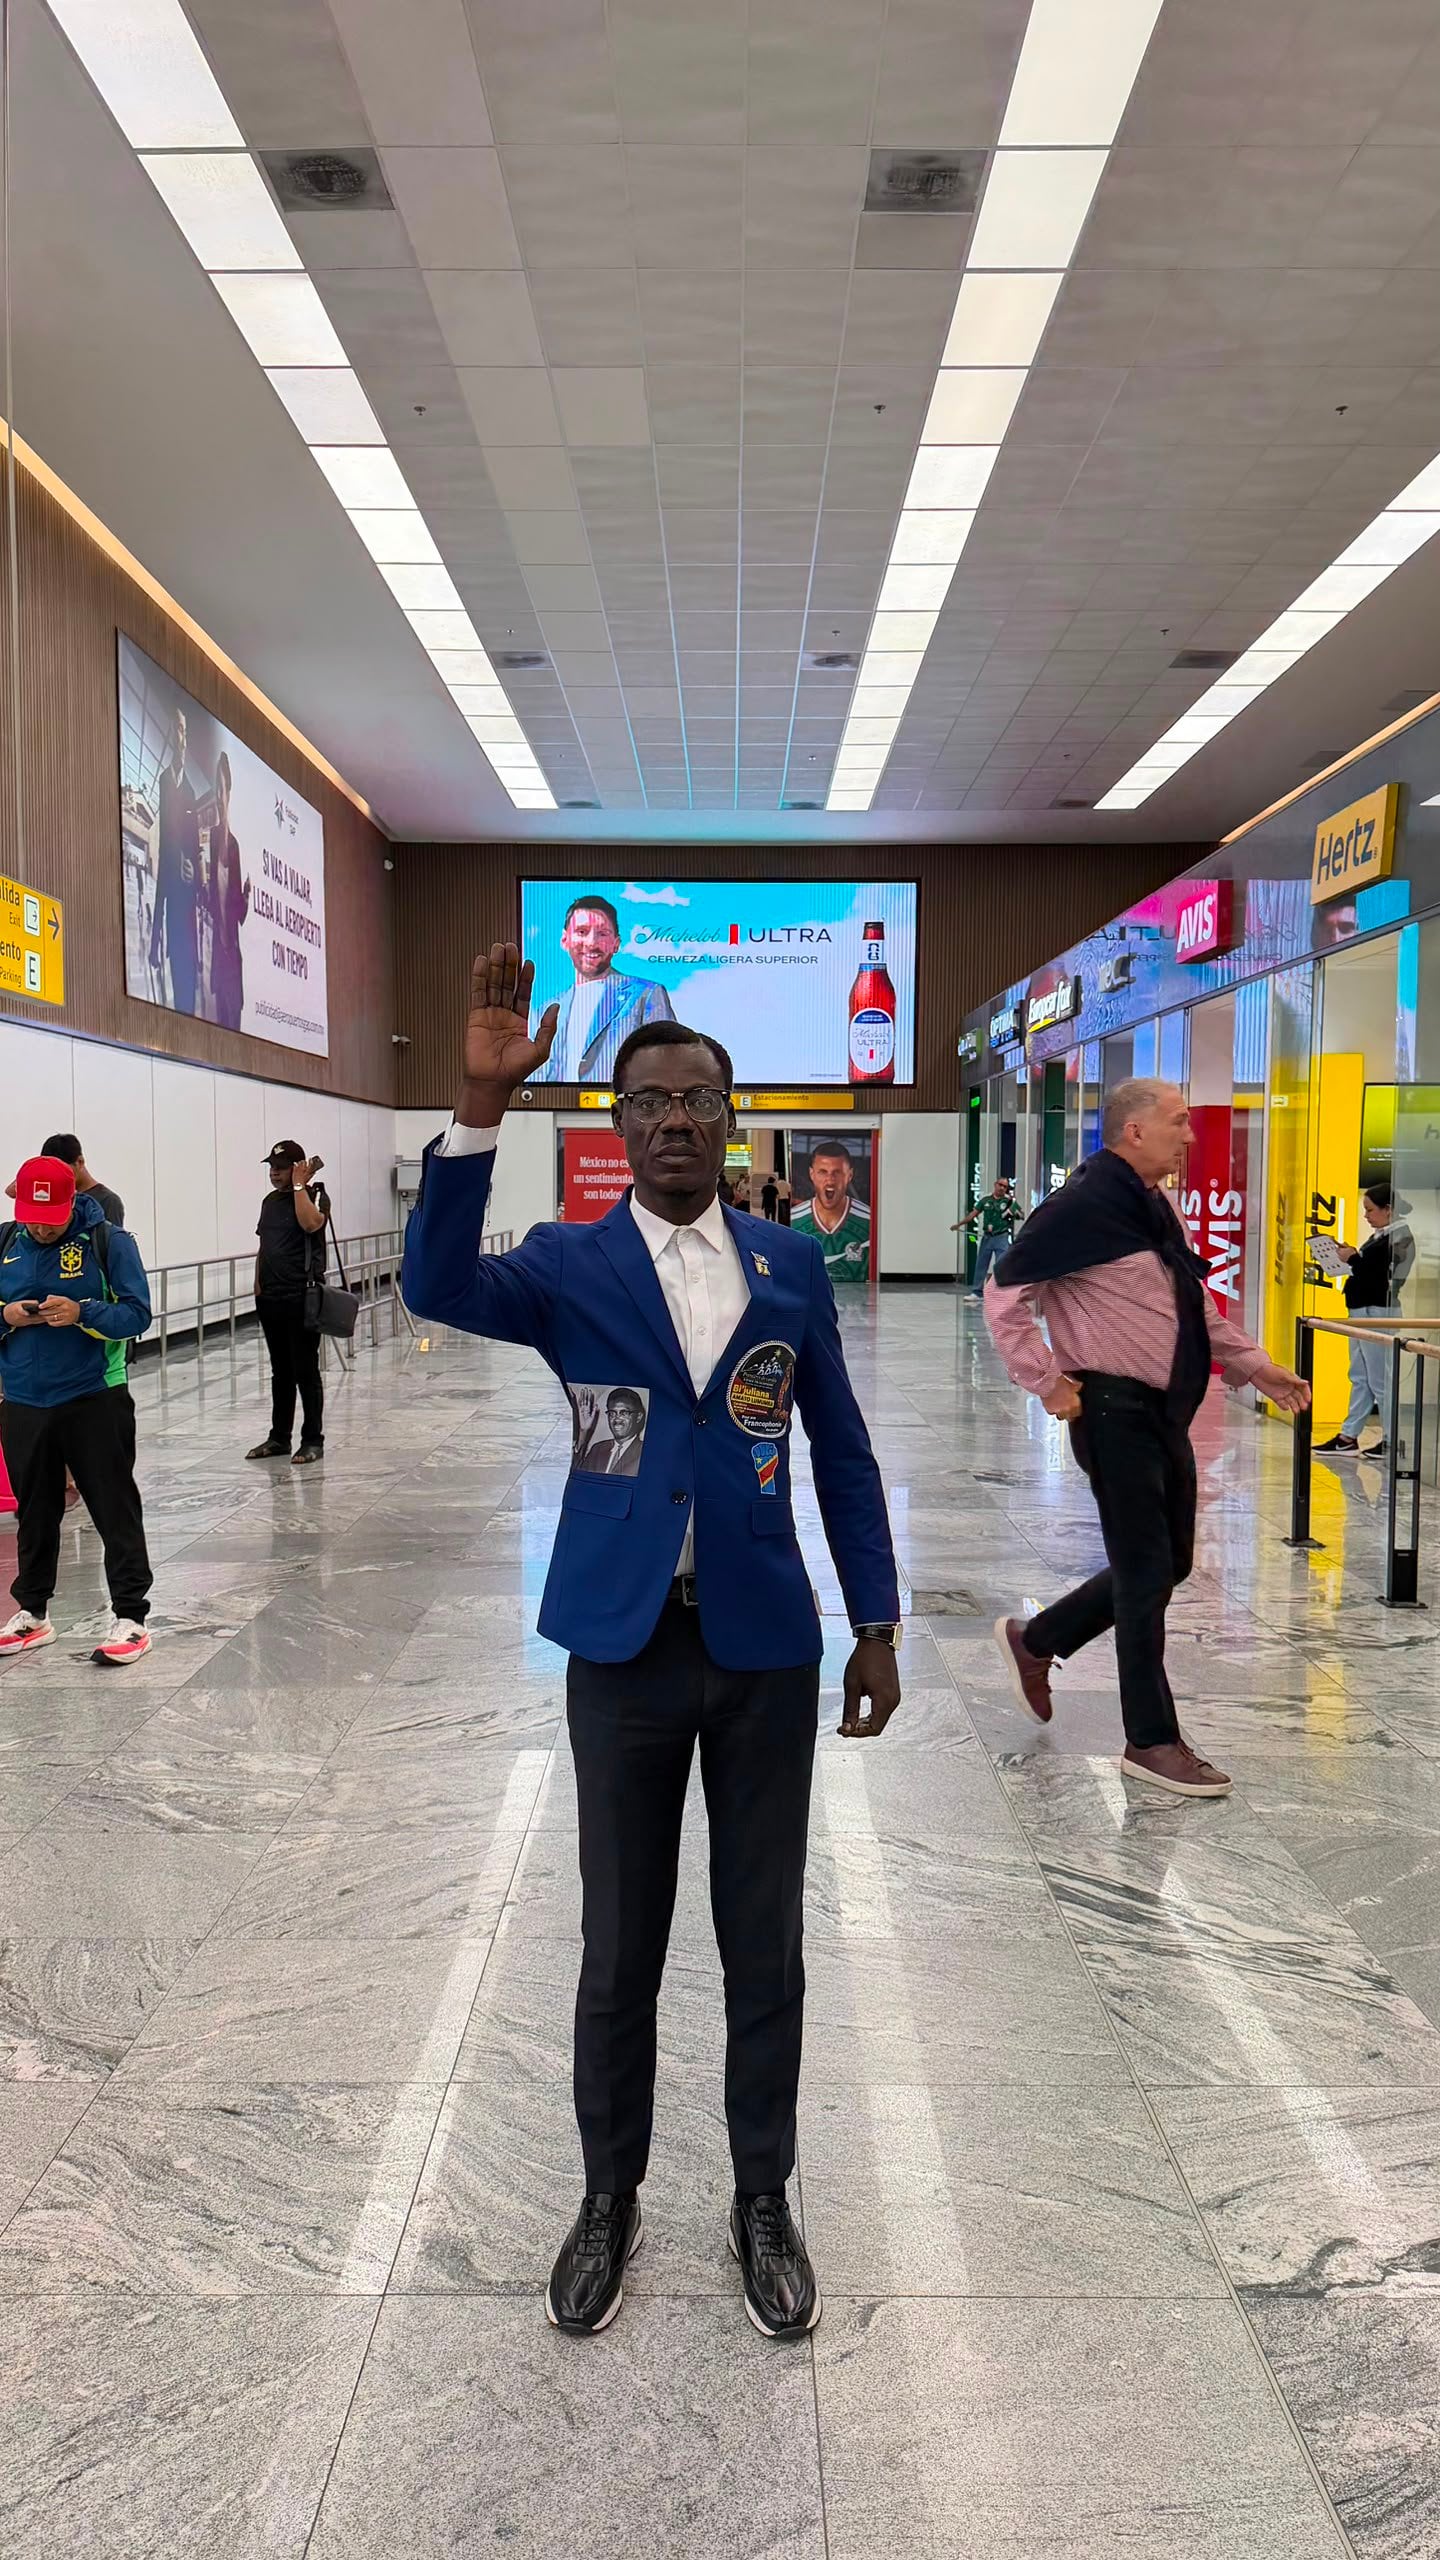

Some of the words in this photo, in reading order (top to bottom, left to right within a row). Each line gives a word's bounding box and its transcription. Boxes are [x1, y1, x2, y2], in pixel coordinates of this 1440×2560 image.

[1317, 818, 1376, 886] Hertz
[262, 848, 270, 878] SI
[270, 853, 283, 886] VAS
[284, 863, 289, 891] A
[0, 881, 20, 906] lida
[253, 885, 275, 923] LLEGA
[275, 899, 284, 928] AL
[285, 905, 322, 949] AEROPUERTO
[1177, 894, 1214, 953] AVIS
[635, 924, 720, 944] Michelob
[749, 928, 832, 943] ULTRA
[272, 940, 285, 970] CON
[286, 947, 308, 980] TIEMPO
[648, 955, 706, 964] CERVEZA
[709, 955, 754, 964] LIGERA
[755, 955, 818, 964] SUPERIOR
[753, 1093, 809, 1101] Estacionamiento
[579, 1155, 607, 1168] México
[608, 1158, 619, 1168] no
[620, 1158, 629, 1168] es
[573, 1174, 584, 1184] un
[585, 1173, 634, 1184] sentimiento
[583, 1191, 599, 1200] son
[599, 1189, 623, 1200] todos
[1207, 1190, 1243, 1301] AVIS
[1304, 1191, 1336, 1289] Hrtz
